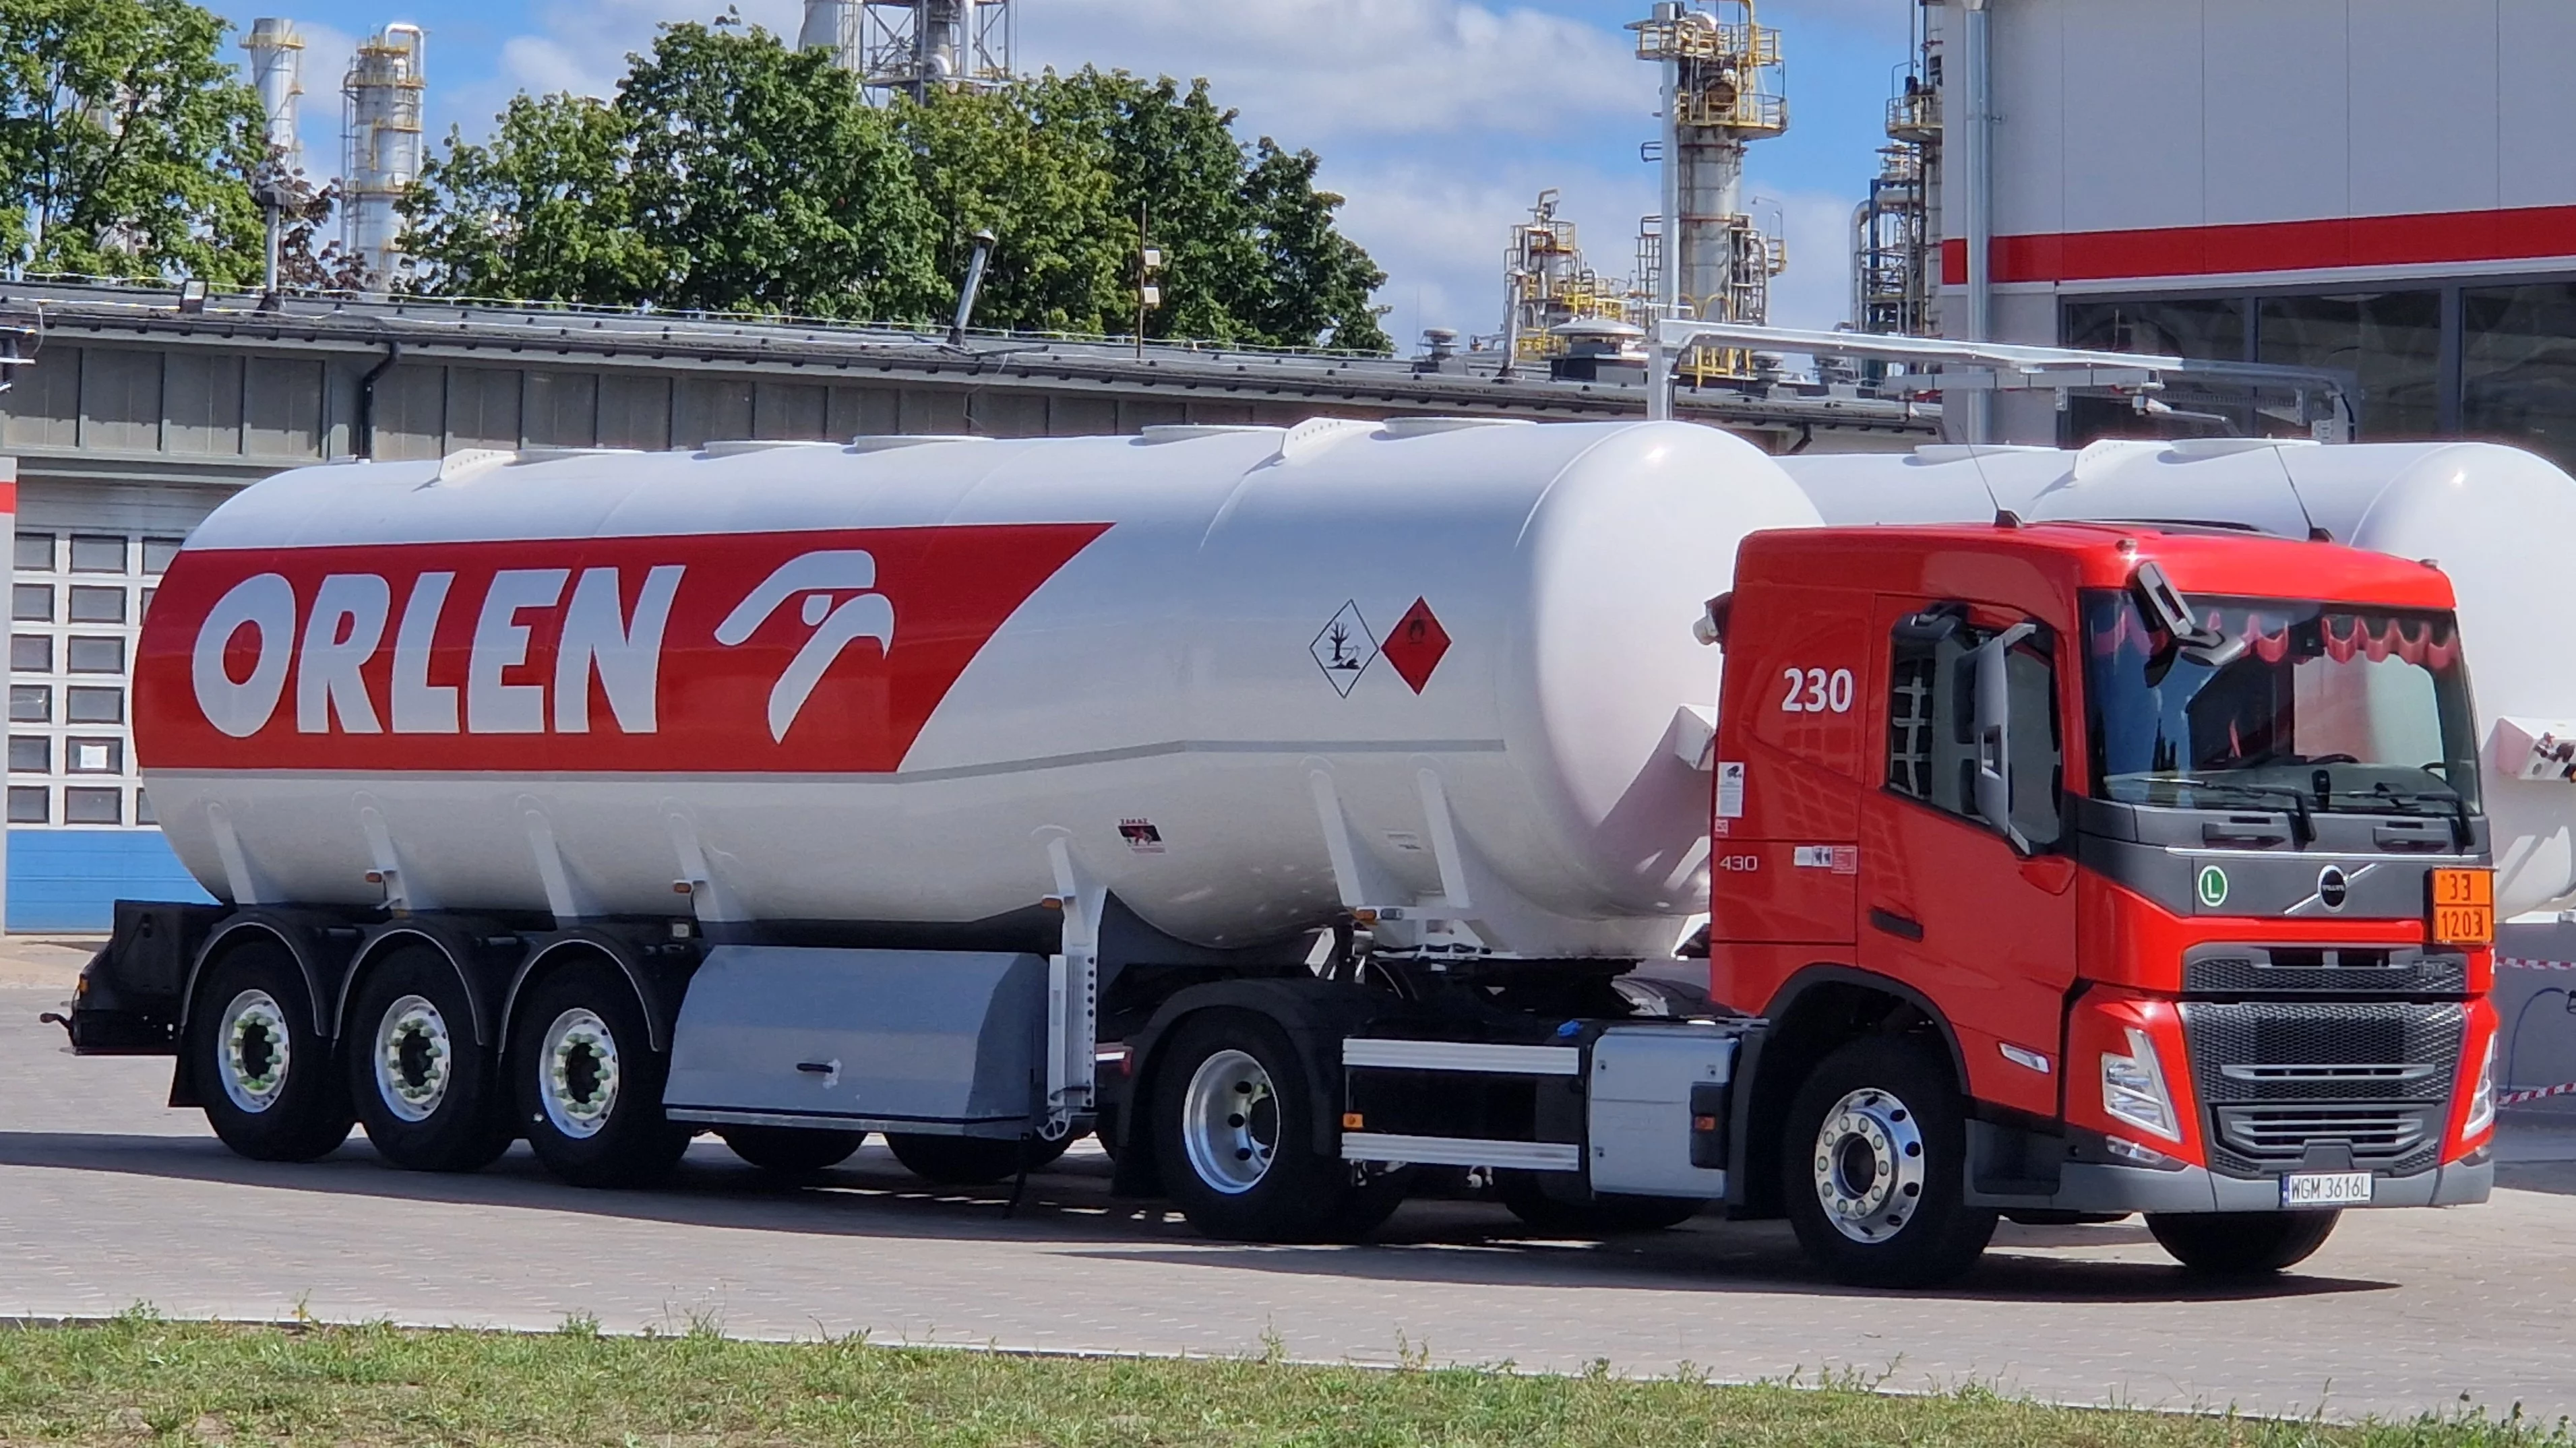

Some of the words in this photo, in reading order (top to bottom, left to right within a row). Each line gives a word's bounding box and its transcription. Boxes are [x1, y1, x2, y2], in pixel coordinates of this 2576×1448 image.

[192, 565, 686, 737] ORLEN
[1781, 668, 1853, 713] 230
[1719, 855, 1758, 871] 430
[2207, 874, 2220, 898] L
[2449, 873, 2471, 901] 33
[2441, 910, 2484, 938] 1203
[2292, 1177, 2321, 1199] WGM
[2325, 1176, 2369, 1199] 3616L
